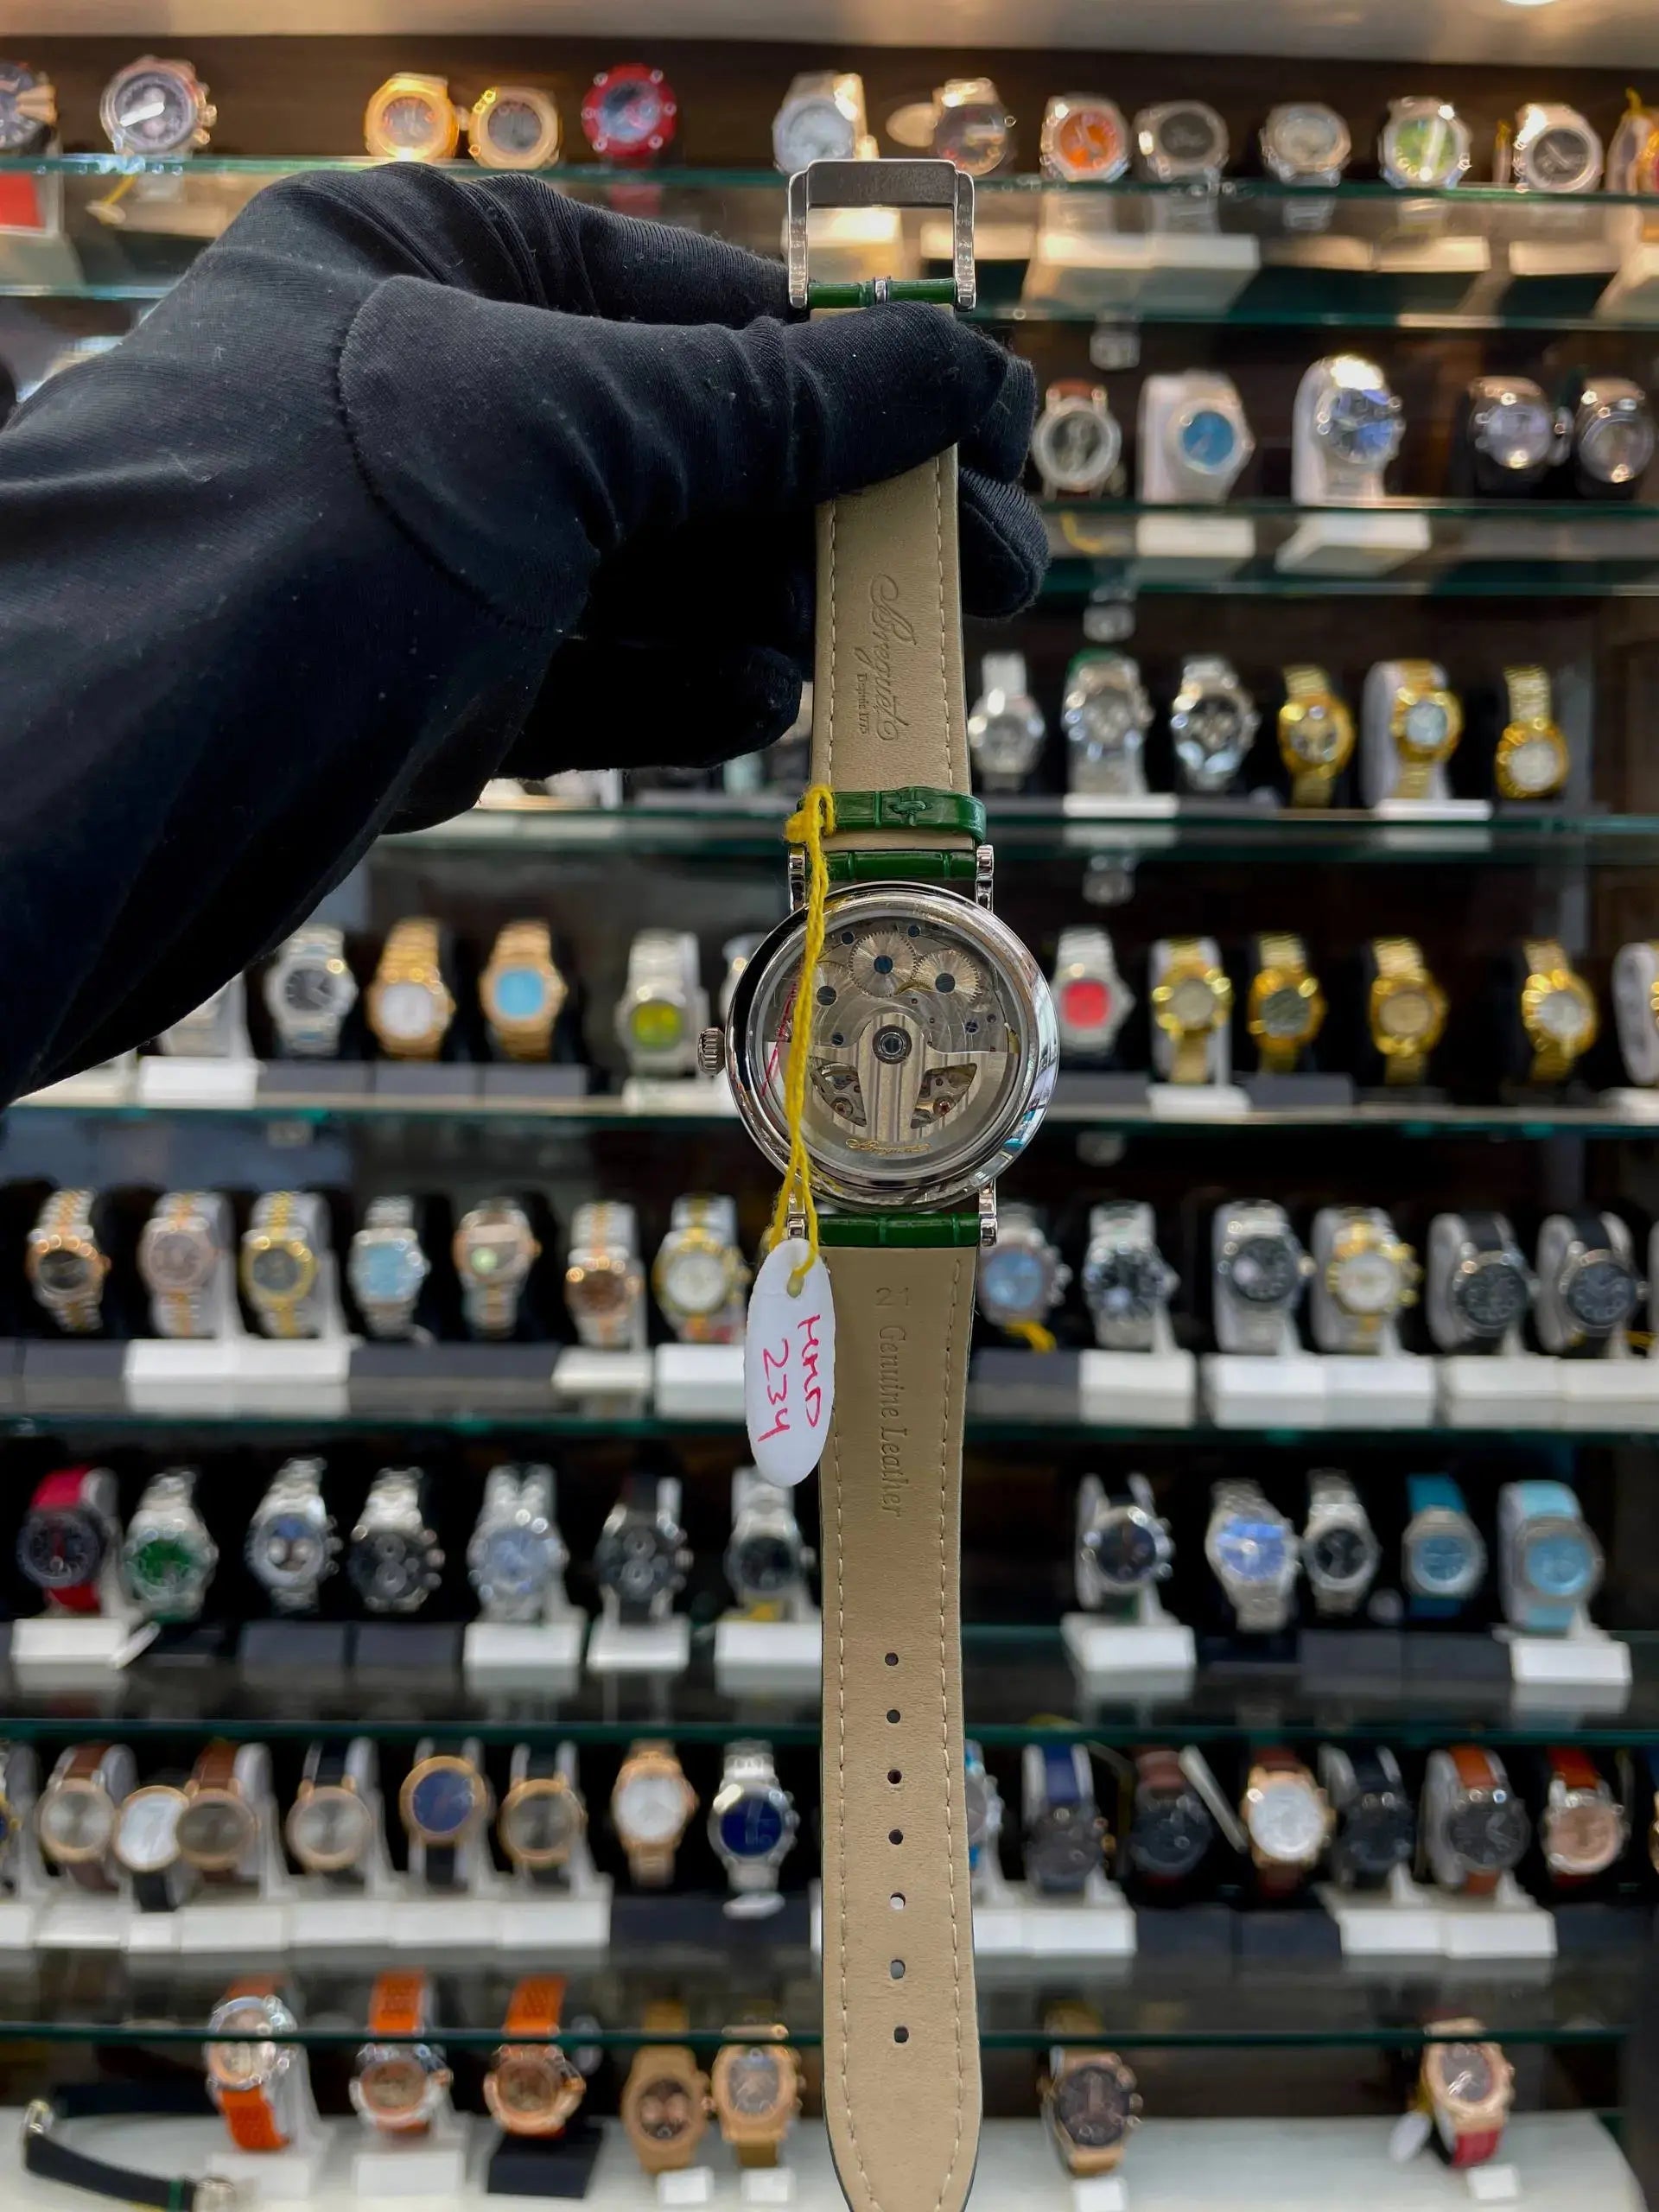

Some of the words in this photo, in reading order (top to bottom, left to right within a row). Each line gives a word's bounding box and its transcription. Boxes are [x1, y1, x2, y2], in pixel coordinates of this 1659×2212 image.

[854, 573, 918, 742] Breguet
[757, 1337, 791, 1443] 234
[879, 1325, 907, 1418] Genuine
[879, 1426, 910, 1518] Leather
